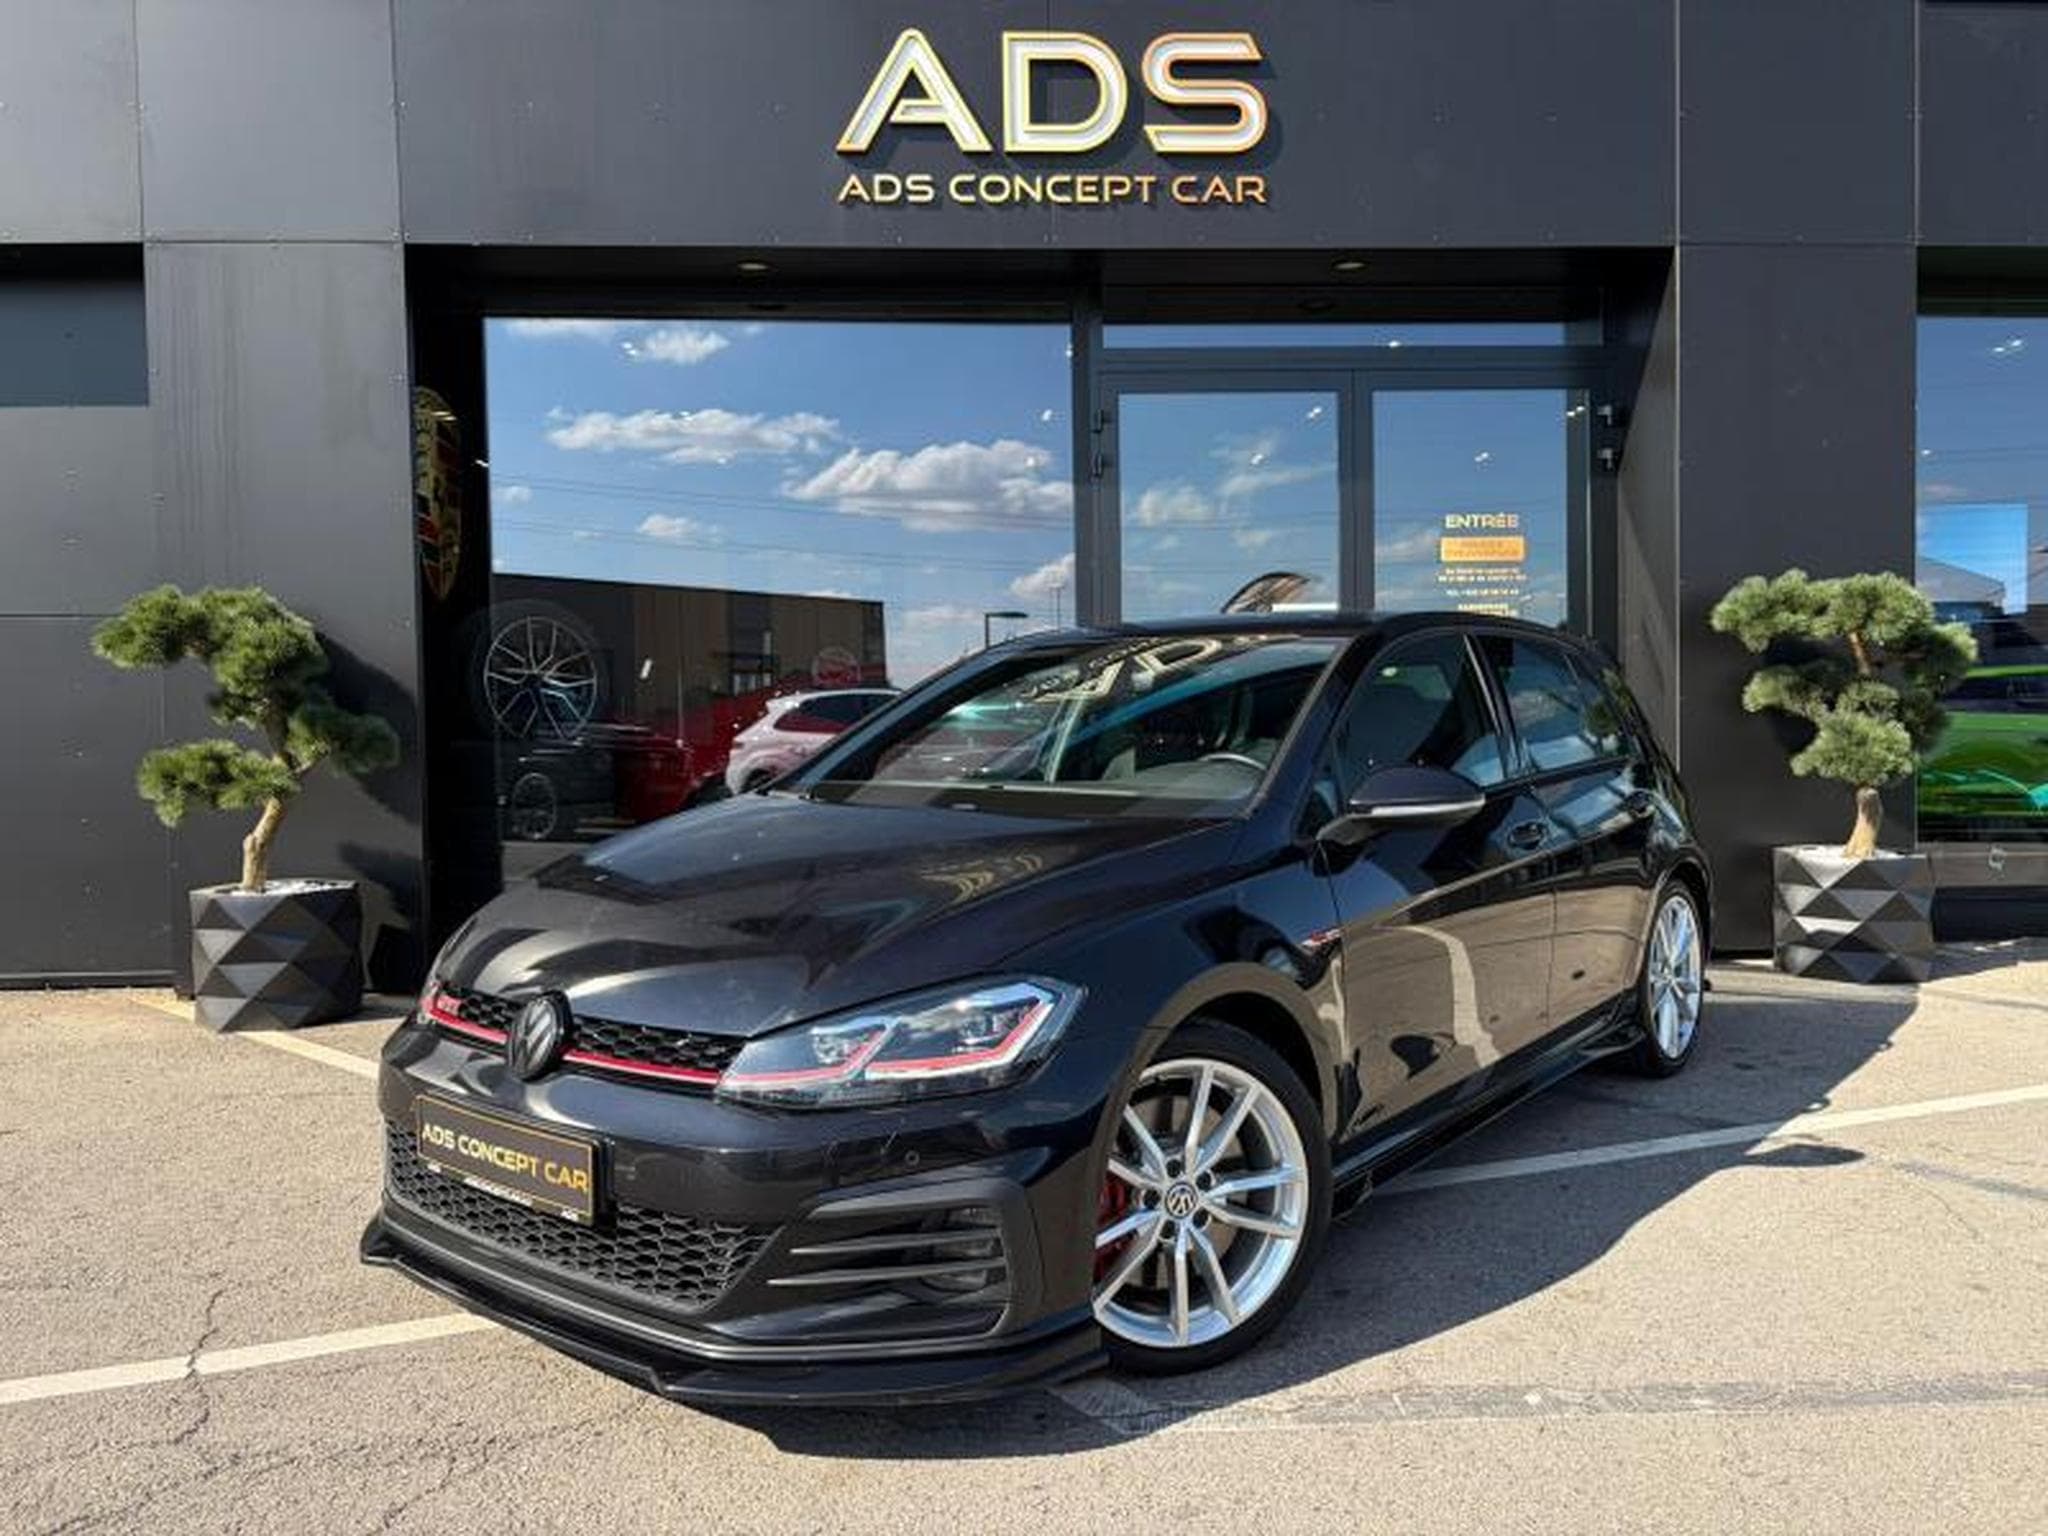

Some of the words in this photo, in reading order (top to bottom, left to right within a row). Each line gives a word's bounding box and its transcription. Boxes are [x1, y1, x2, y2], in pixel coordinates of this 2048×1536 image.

[836, 27, 1268, 154] ADS
[837, 174, 936, 204] ADS
[949, 174, 1157, 204] CONCEPT
[1170, 175, 1268, 204] CAR
[1445, 512, 1520, 529] ENTRÉE
[421, 1122, 456, 1150] ADS
[457, 1135, 540, 1178] CONCEPT
[544, 1162, 589, 1193] CAR
